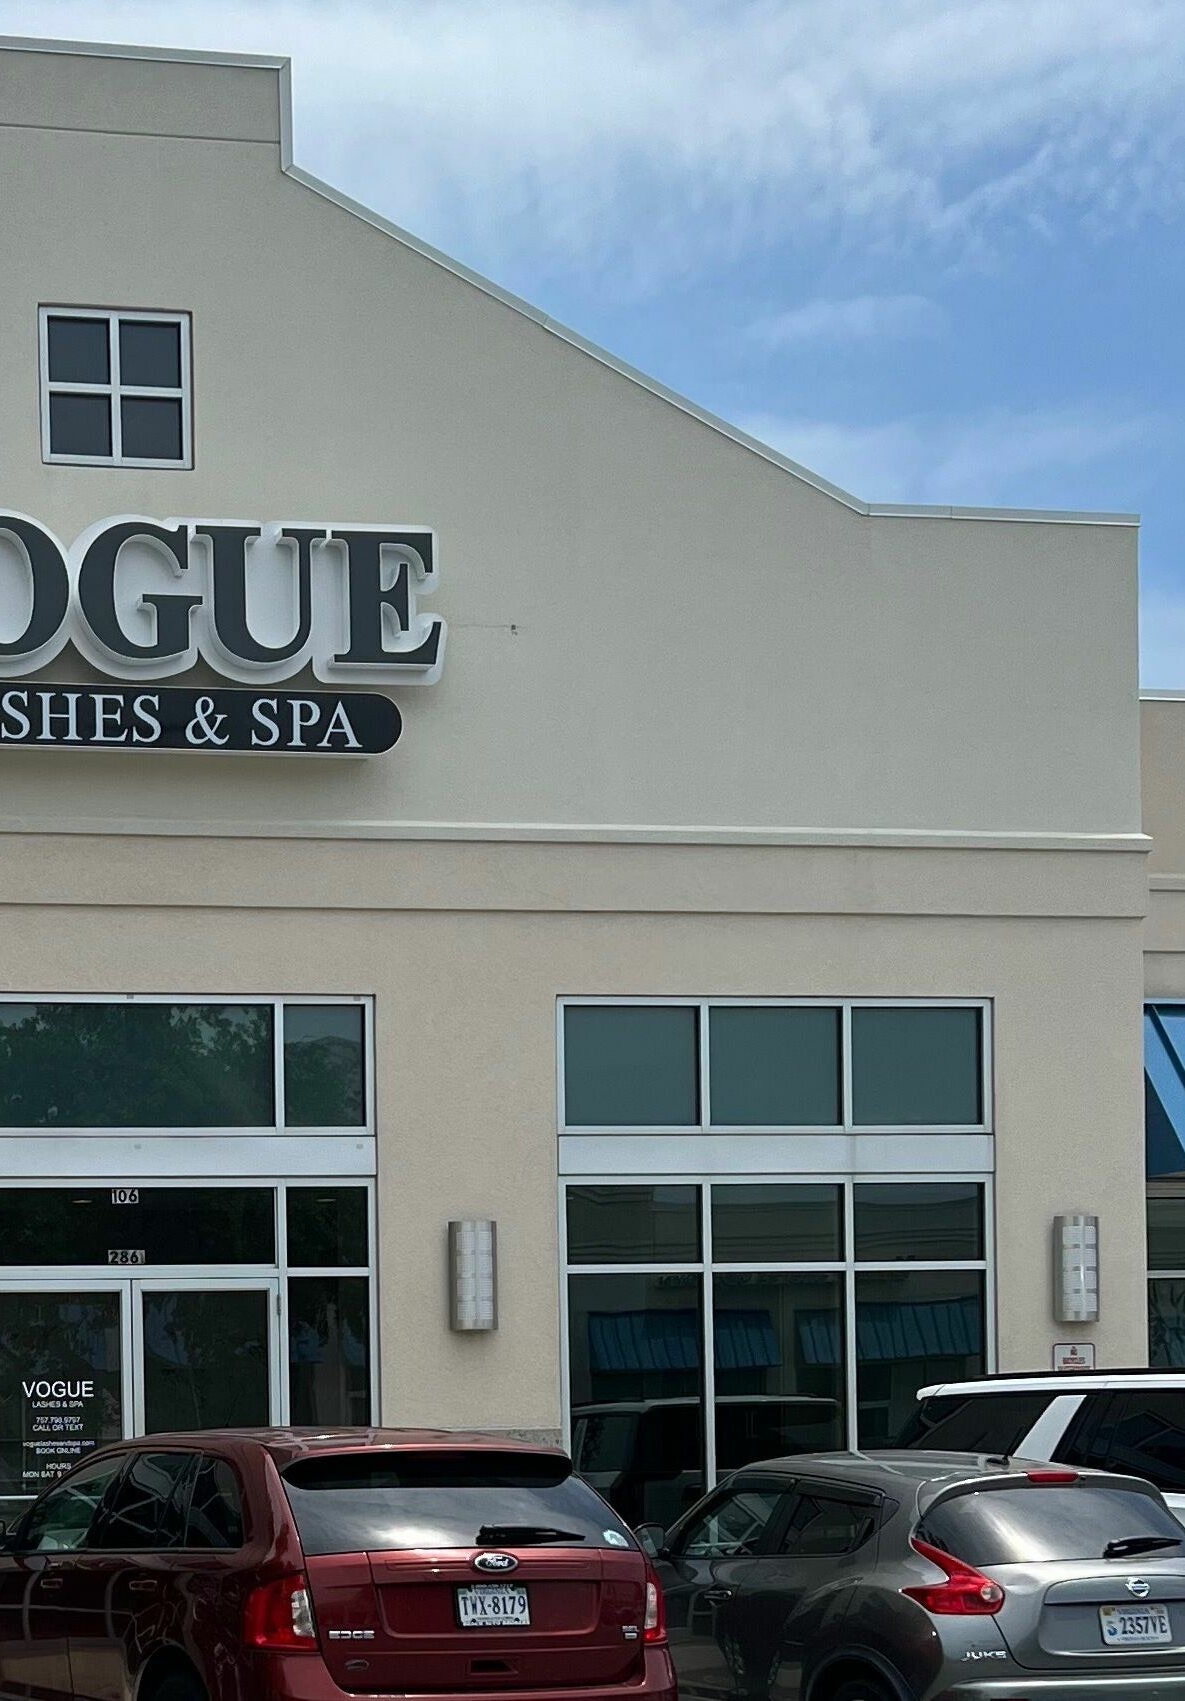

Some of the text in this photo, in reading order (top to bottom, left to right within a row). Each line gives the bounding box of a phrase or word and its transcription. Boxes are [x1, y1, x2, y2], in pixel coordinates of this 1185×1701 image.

[184, 696, 231, 747] &
[250, 698, 363, 749] SPA
[113, 1189, 138, 1203] 106
[21, 1380, 95, 1397] VOGUE
[32, 1400, 61, 1408] LASHES
[69, 1400, 84, 1408] SPA
[32, 1424, 84, 1432] CALL OR TEXT
